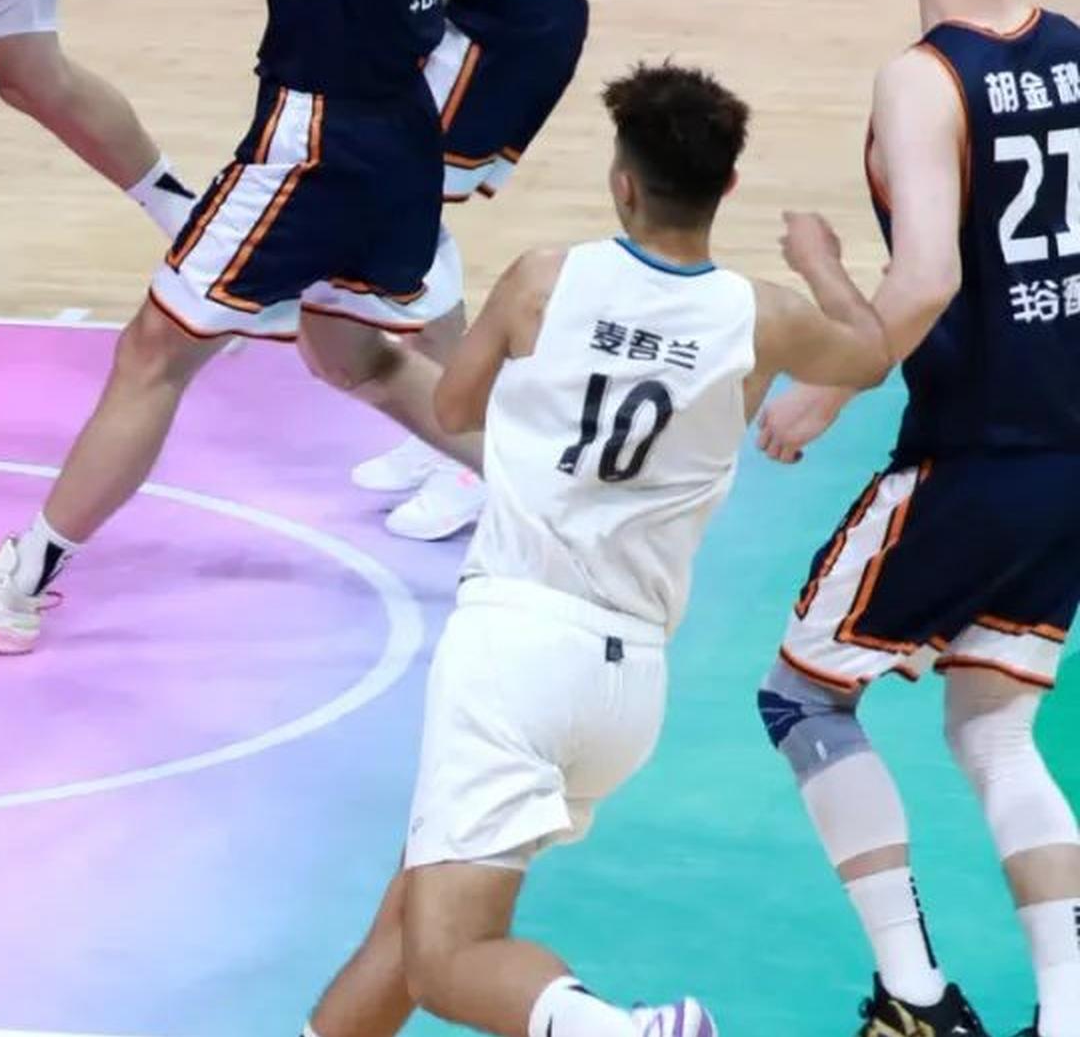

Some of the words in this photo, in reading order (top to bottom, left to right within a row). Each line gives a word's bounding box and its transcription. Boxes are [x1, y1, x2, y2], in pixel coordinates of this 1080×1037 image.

[994, 128, 1080, 264] 21
[590, 320, 700, 370] 麦吾兰
[556, 373, 674, 483] 10
